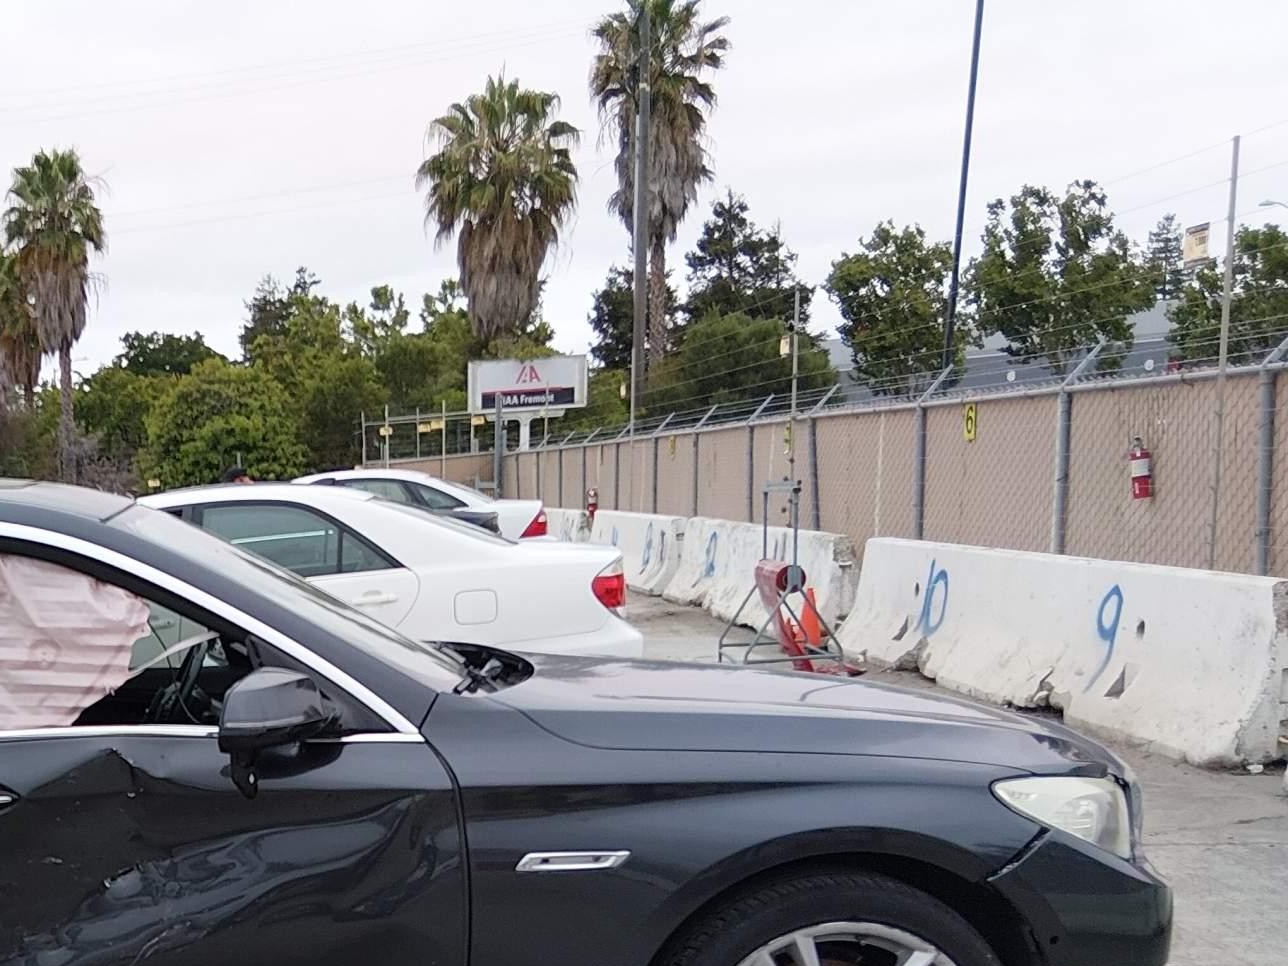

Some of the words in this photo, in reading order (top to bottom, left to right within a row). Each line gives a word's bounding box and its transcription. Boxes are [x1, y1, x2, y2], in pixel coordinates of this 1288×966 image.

[503, 395, 519, 405] IAA
[966, 405, 974, 434] 6
[1083, 584, 1124, 694] 9
